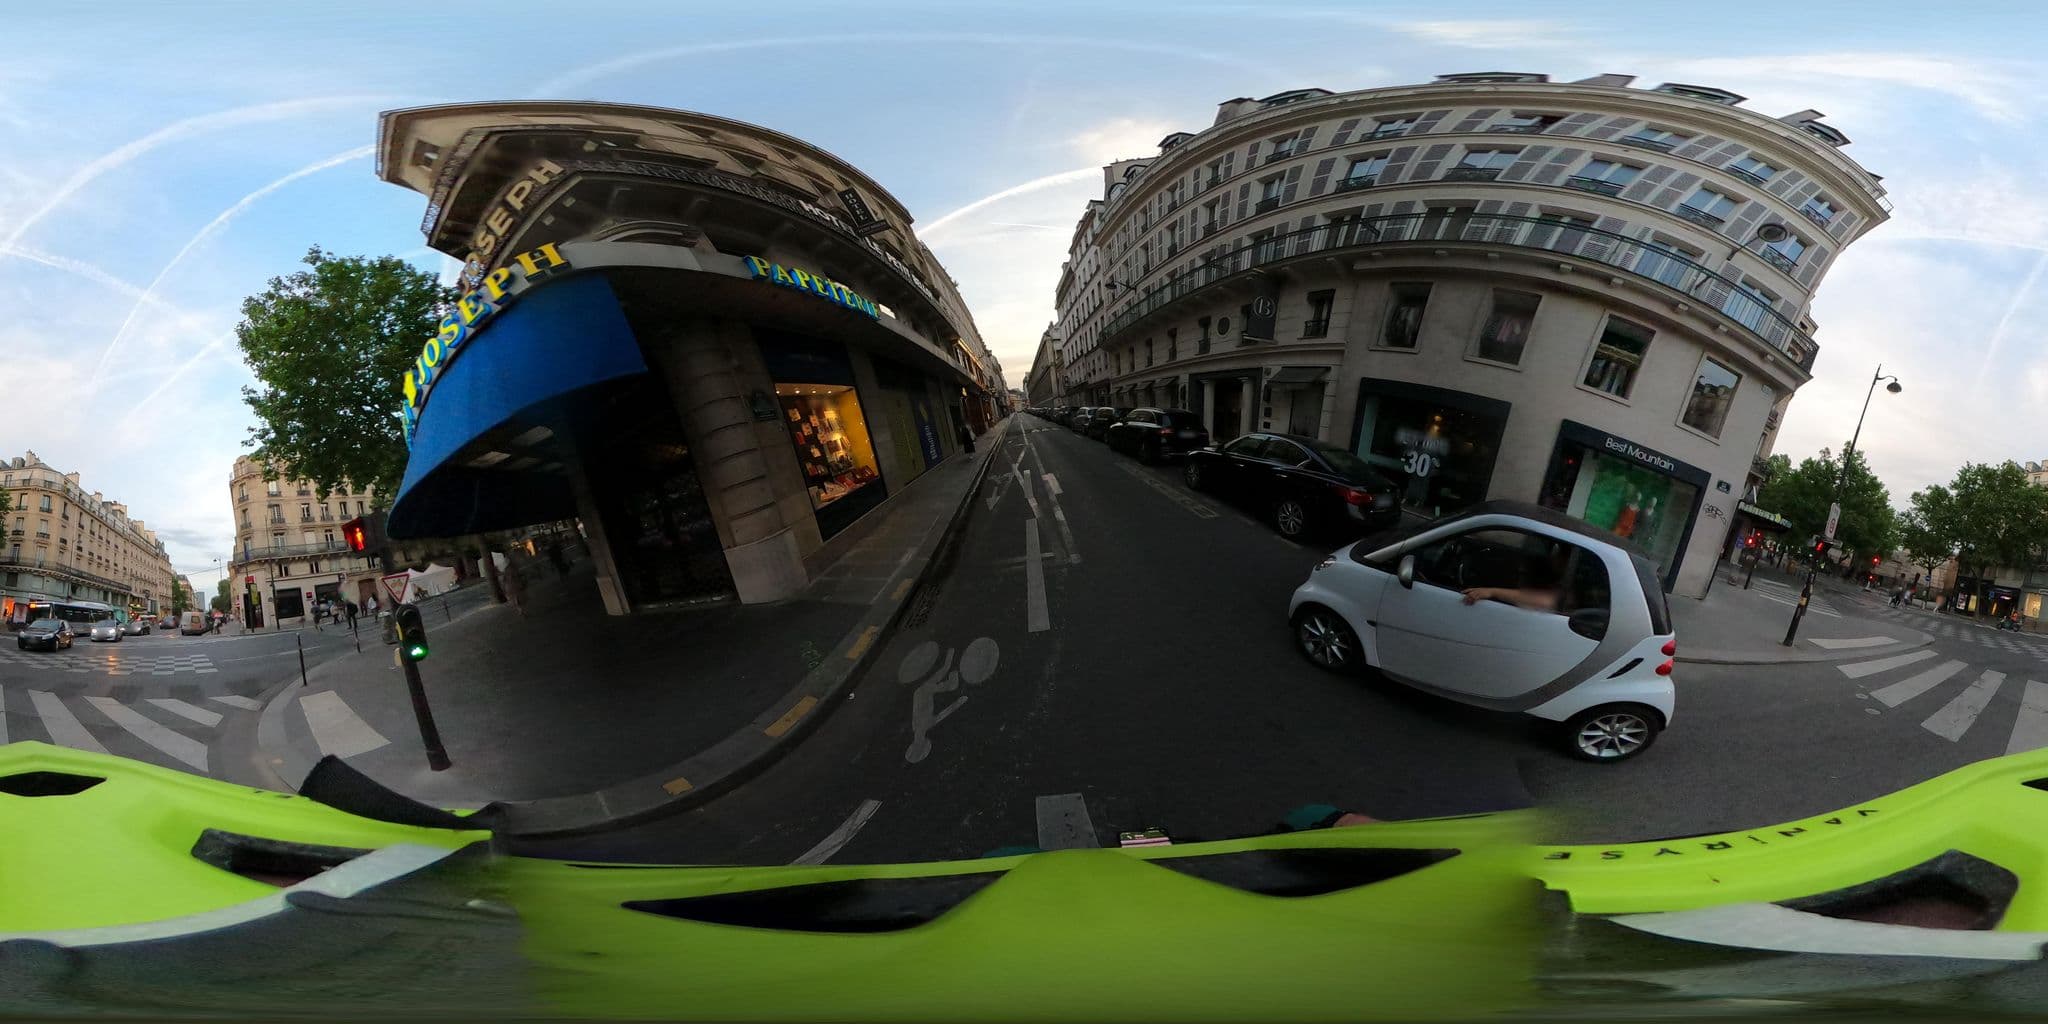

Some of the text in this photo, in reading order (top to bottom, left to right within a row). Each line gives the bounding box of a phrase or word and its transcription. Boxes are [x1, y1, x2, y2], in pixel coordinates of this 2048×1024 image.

[844, 192, 869, 221] HOTEL
[743, 255, 881, 321] PAPETERIE
[416, 242, 571, 385] JOSEPH
[1605, 437, 1675, 472] Best Mountain
